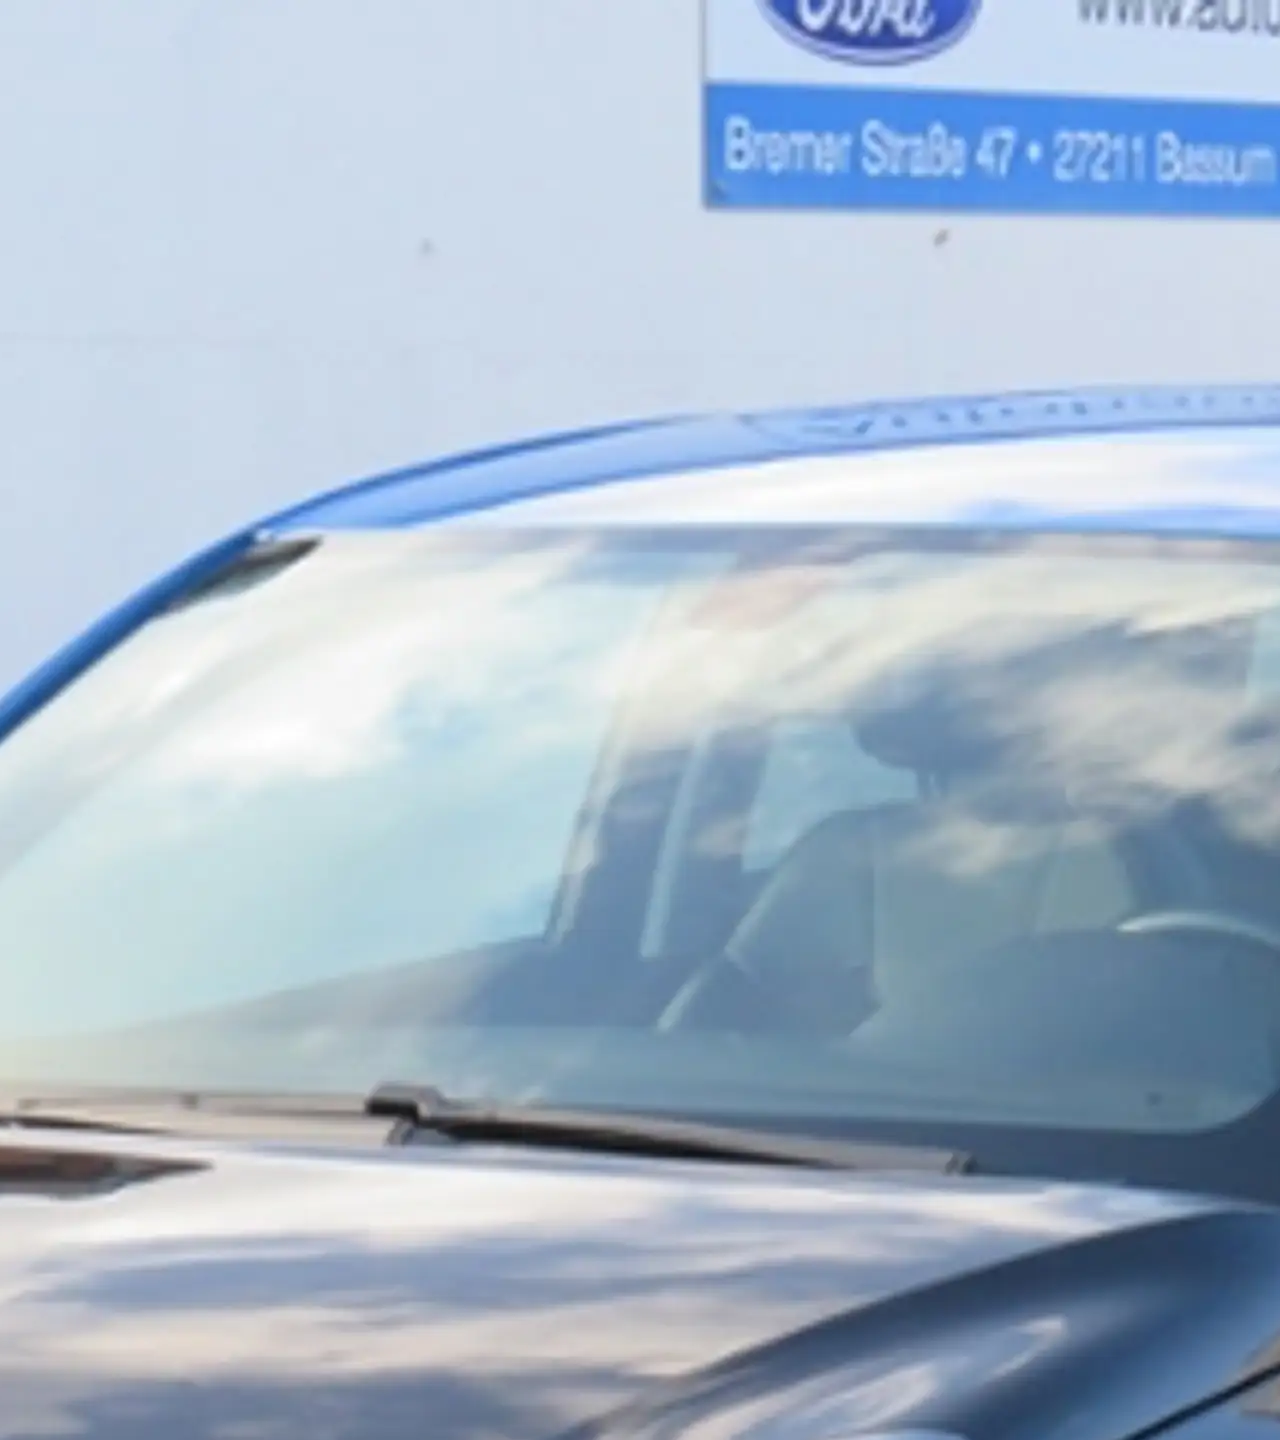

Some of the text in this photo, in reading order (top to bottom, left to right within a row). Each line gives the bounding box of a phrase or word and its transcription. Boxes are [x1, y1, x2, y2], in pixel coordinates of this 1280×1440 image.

[723, 114, 853, 174] Bremer
[861, 118, 968, 178] Straße
[976, 126, 1017, 178] 47
[1053, 129, 1147, 182] 27211
[1156, 130, 1277, 185] Bassum
